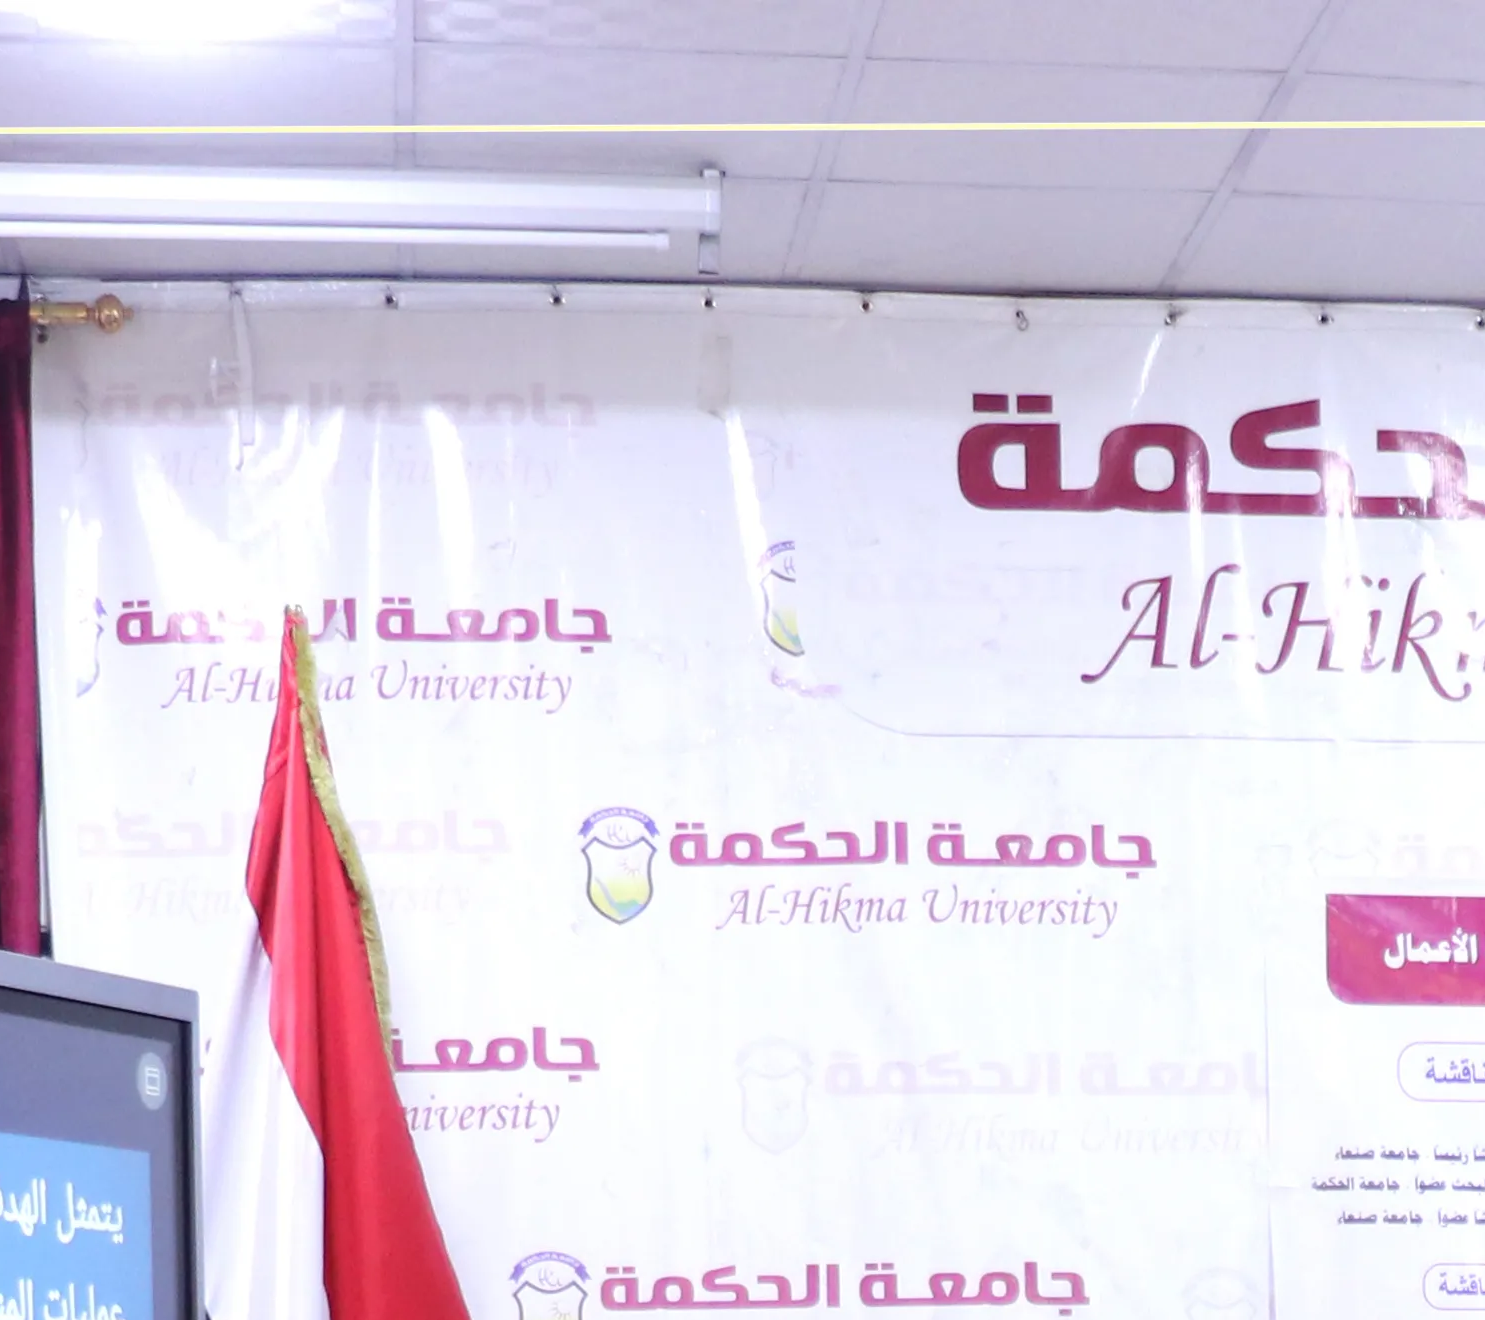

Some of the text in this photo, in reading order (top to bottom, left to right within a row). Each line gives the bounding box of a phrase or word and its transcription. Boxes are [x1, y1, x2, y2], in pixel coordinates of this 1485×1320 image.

[376, 597, 613, 654] جامعة
[368, 660, 573, 715] University
[669, 821, 1158, 882] جامعة الحكمة
[717, 884, 1120, 940] Al-Hikma University
[1384, 930, 1479, 969] الأعمال
[56, 1182, 124, 1244] يتمثل
[600, 1262, 1090, 1319] جامعة الحكمة
